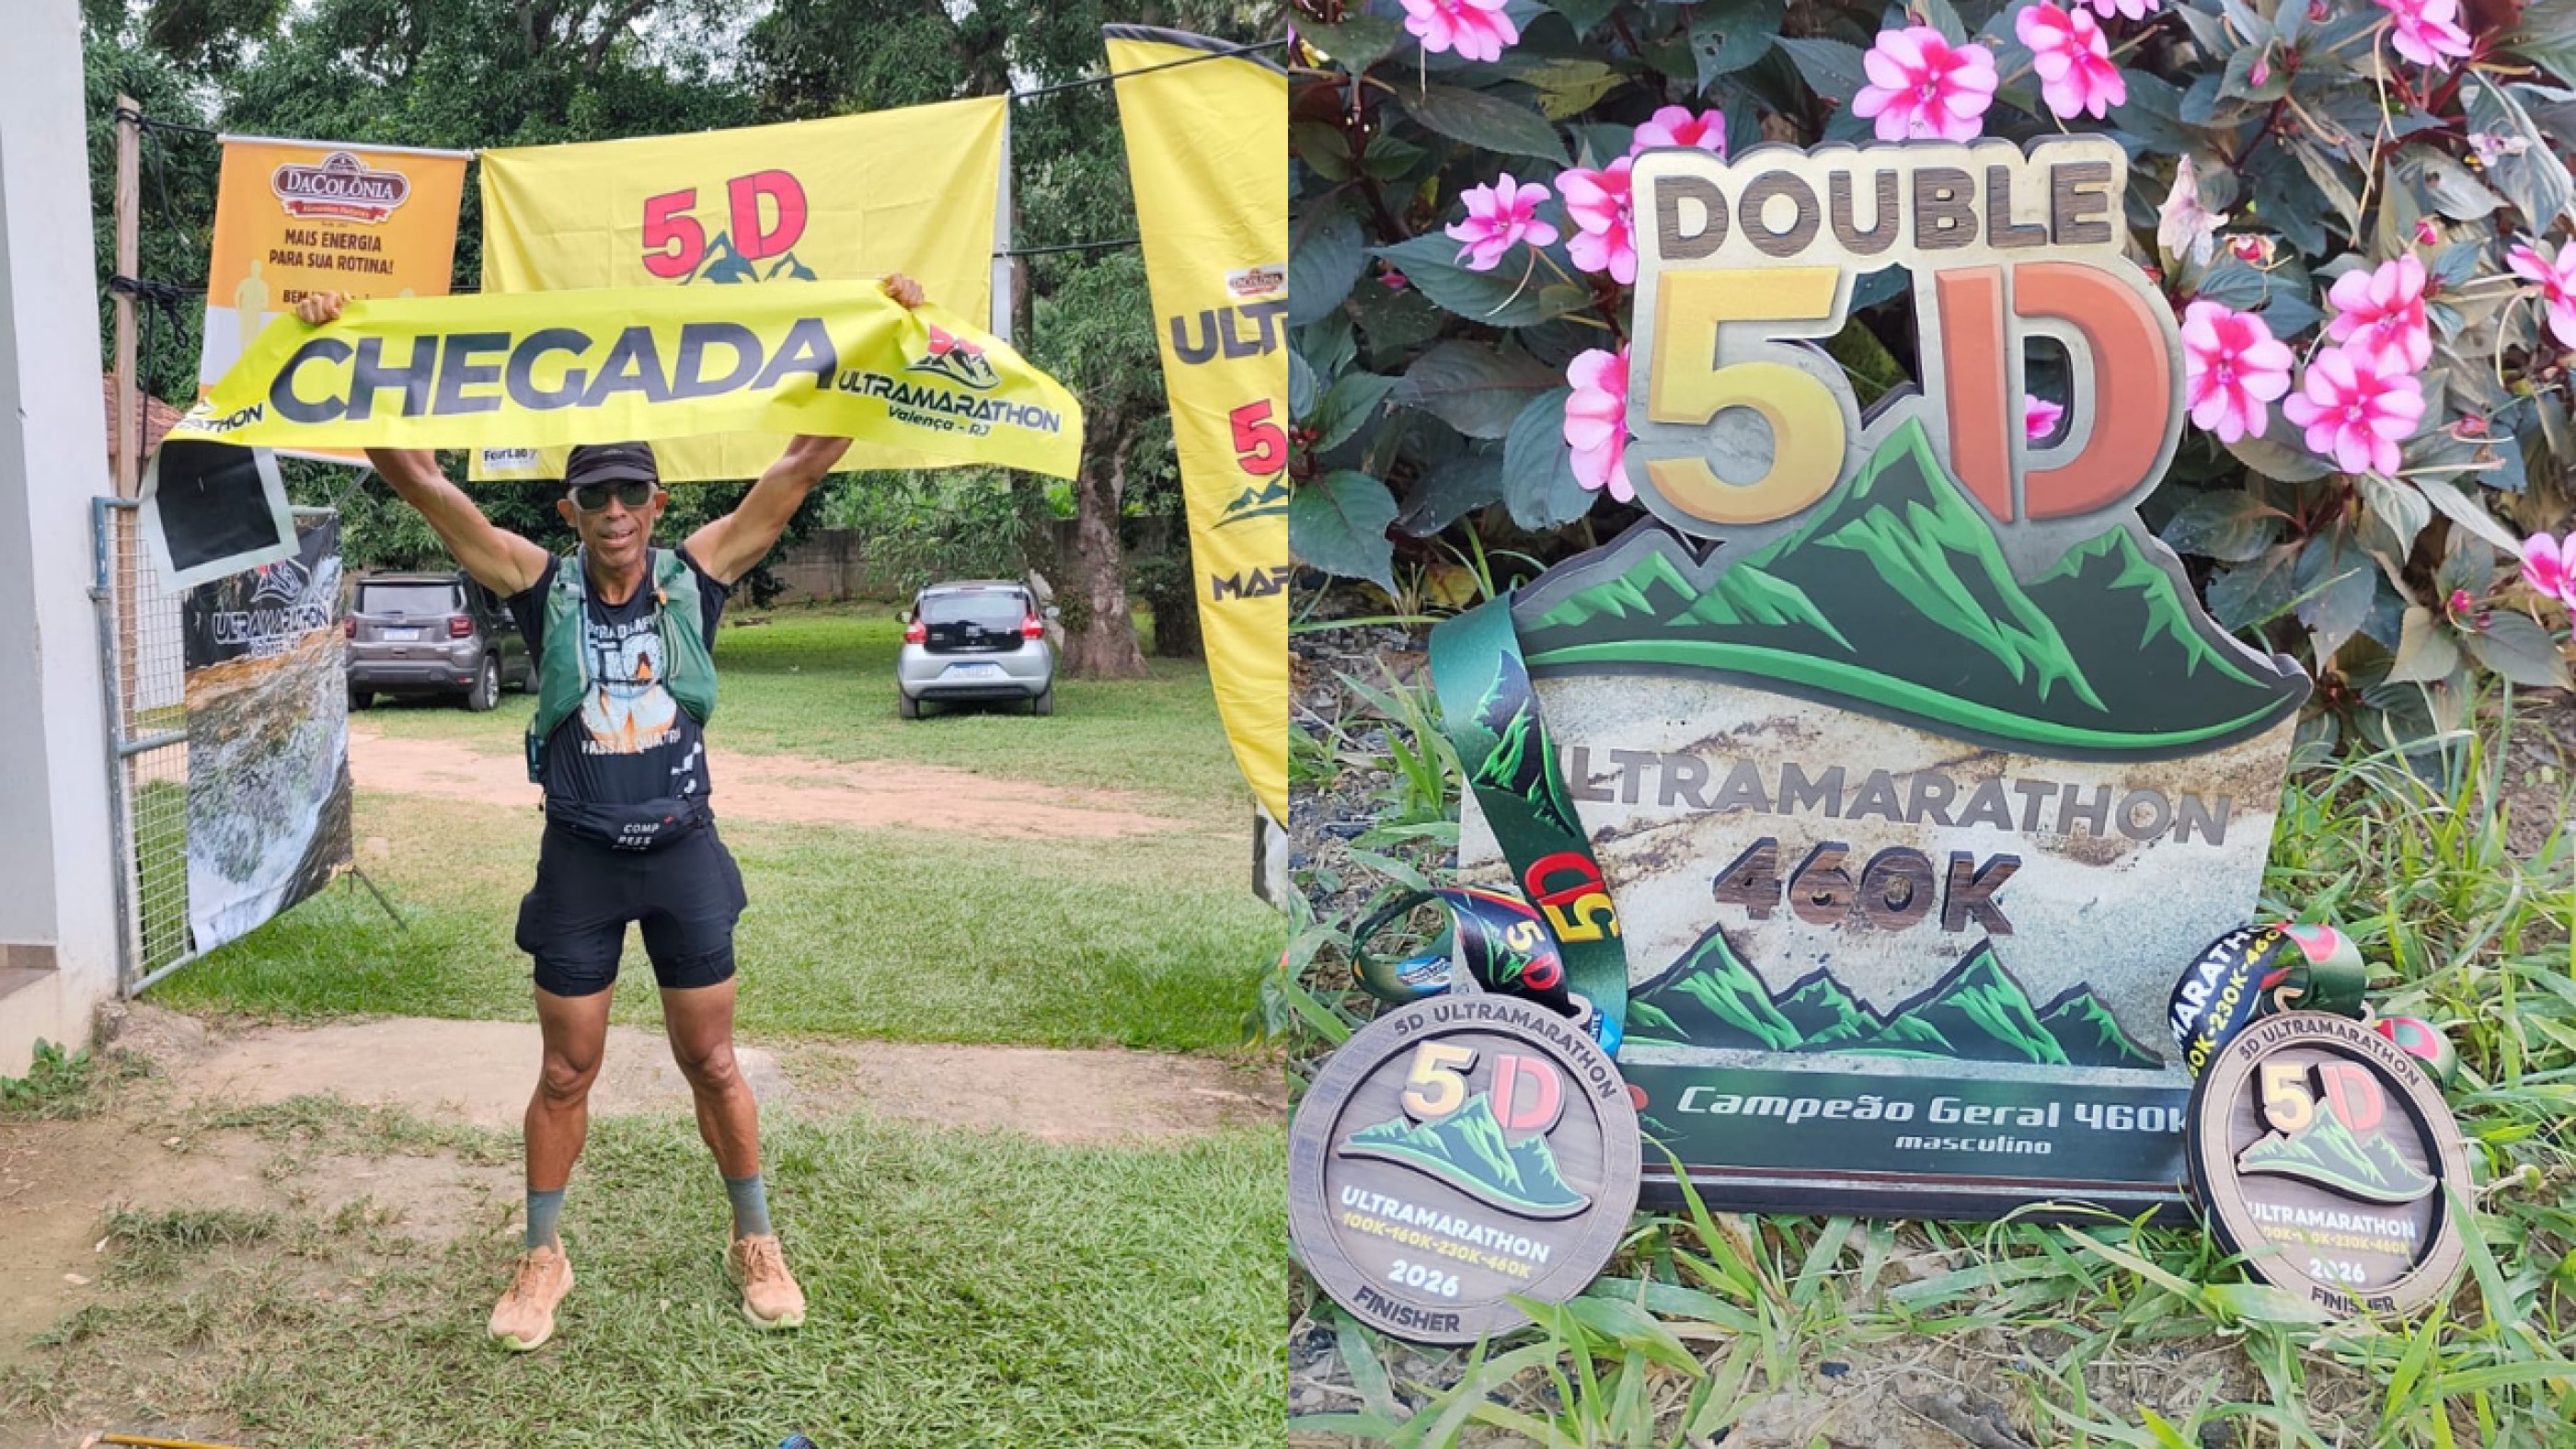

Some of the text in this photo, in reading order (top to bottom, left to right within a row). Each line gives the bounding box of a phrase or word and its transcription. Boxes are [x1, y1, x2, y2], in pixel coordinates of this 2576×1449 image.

[285, 229, 381, 252] MAIS ENERGIA
[642, 169, 807, 279] 5D
[1657, 160, 2113, 260] DOUBLE
[270, 249, 394, 274] PARA SUA ROTINA!
[1169, 298, 1287, 365] ULT
[270, 317, 838, 423] CHEGADA
[838, 370, 1061, 432] ULTRAMARATHON
[1645, 261, 2172, 526] 5D
[889, 406, 954, 431] Valença
[623, 823, 660, 834] COMP
[1525, 852, 1622, 943] 5D
[1712, 836, 2022, 936] 460K
[1506, 920, 1560, 990] 5D
[1394, 1014, 1424, 1036] 5D
[1434, 1004, 1616, 1099] ULTRAMARATHON
[2239, 1039, 2261, 1060] 5D
[2261, 1019, 2421, 1086] ULTRAMARATHON
[1404, 1041, 1561, 1130] 5D
[1677, 1087, 1915, 1124] Campeão
[1929, 1097, 2061, 1128] Geral
[2264, 1064, 2384, 1132] 5D
[1895, 1133, 2052, 1155] masculino
[1341, 1185, 1551, 1263] ULTRAMARATHON
[1342, 1212, 1533, 1279] 100K-160K-230K-460K
[1352, 1285, 1461, 1332] FINISHER
[1387, 1259, 1460, 1297] 2026
